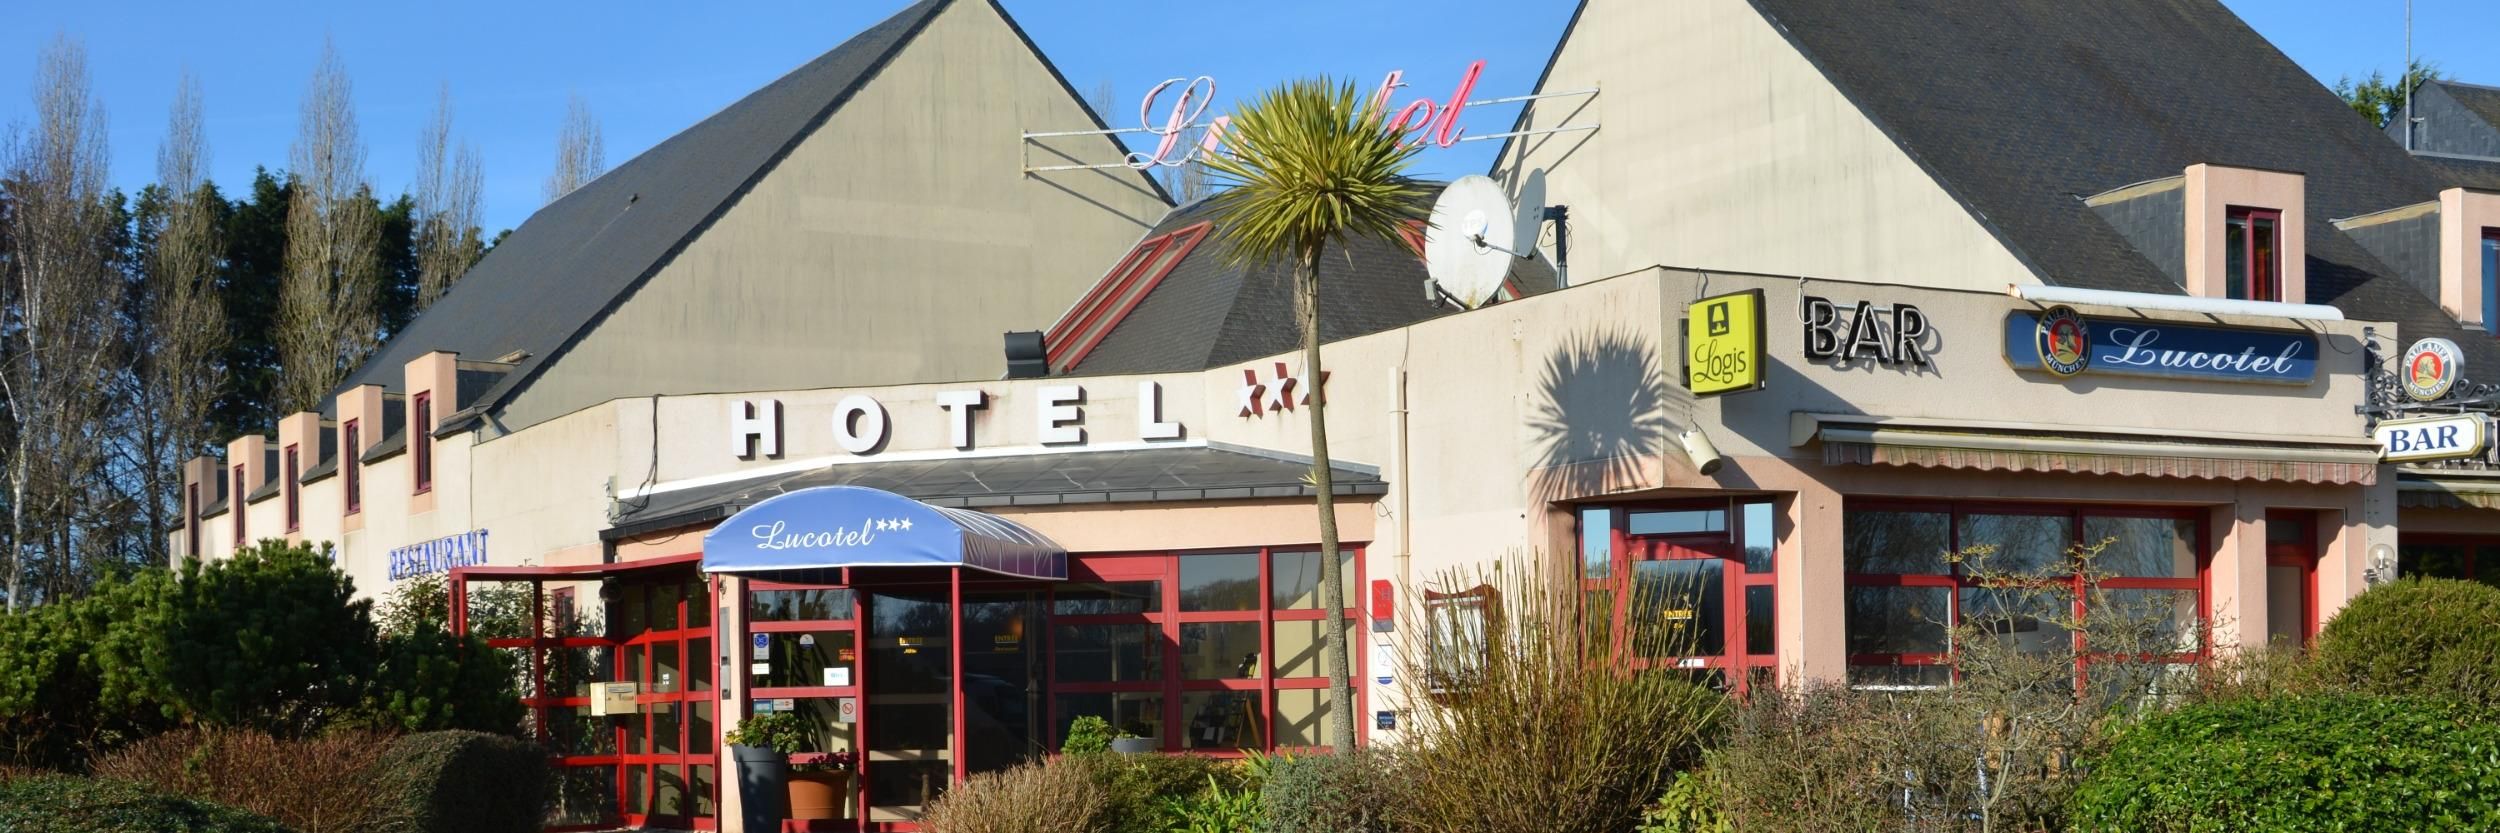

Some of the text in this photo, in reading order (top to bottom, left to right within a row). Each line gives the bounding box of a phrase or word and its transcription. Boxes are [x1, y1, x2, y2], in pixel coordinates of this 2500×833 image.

[1803, 295, 1927, 366] BAR
[2041, 309, 2087, 336] PAULANER
[1692, 338, 1747, 385] Logis
[2102, 327, 2303, 375] Lucotel
[731, 380, 1187, 460] HOTEL
[2389, 425, 2459, 453] BAR
[388, 528, 489, 582] RESTAURANT
[751, 516, 876, 551] Lucotel
